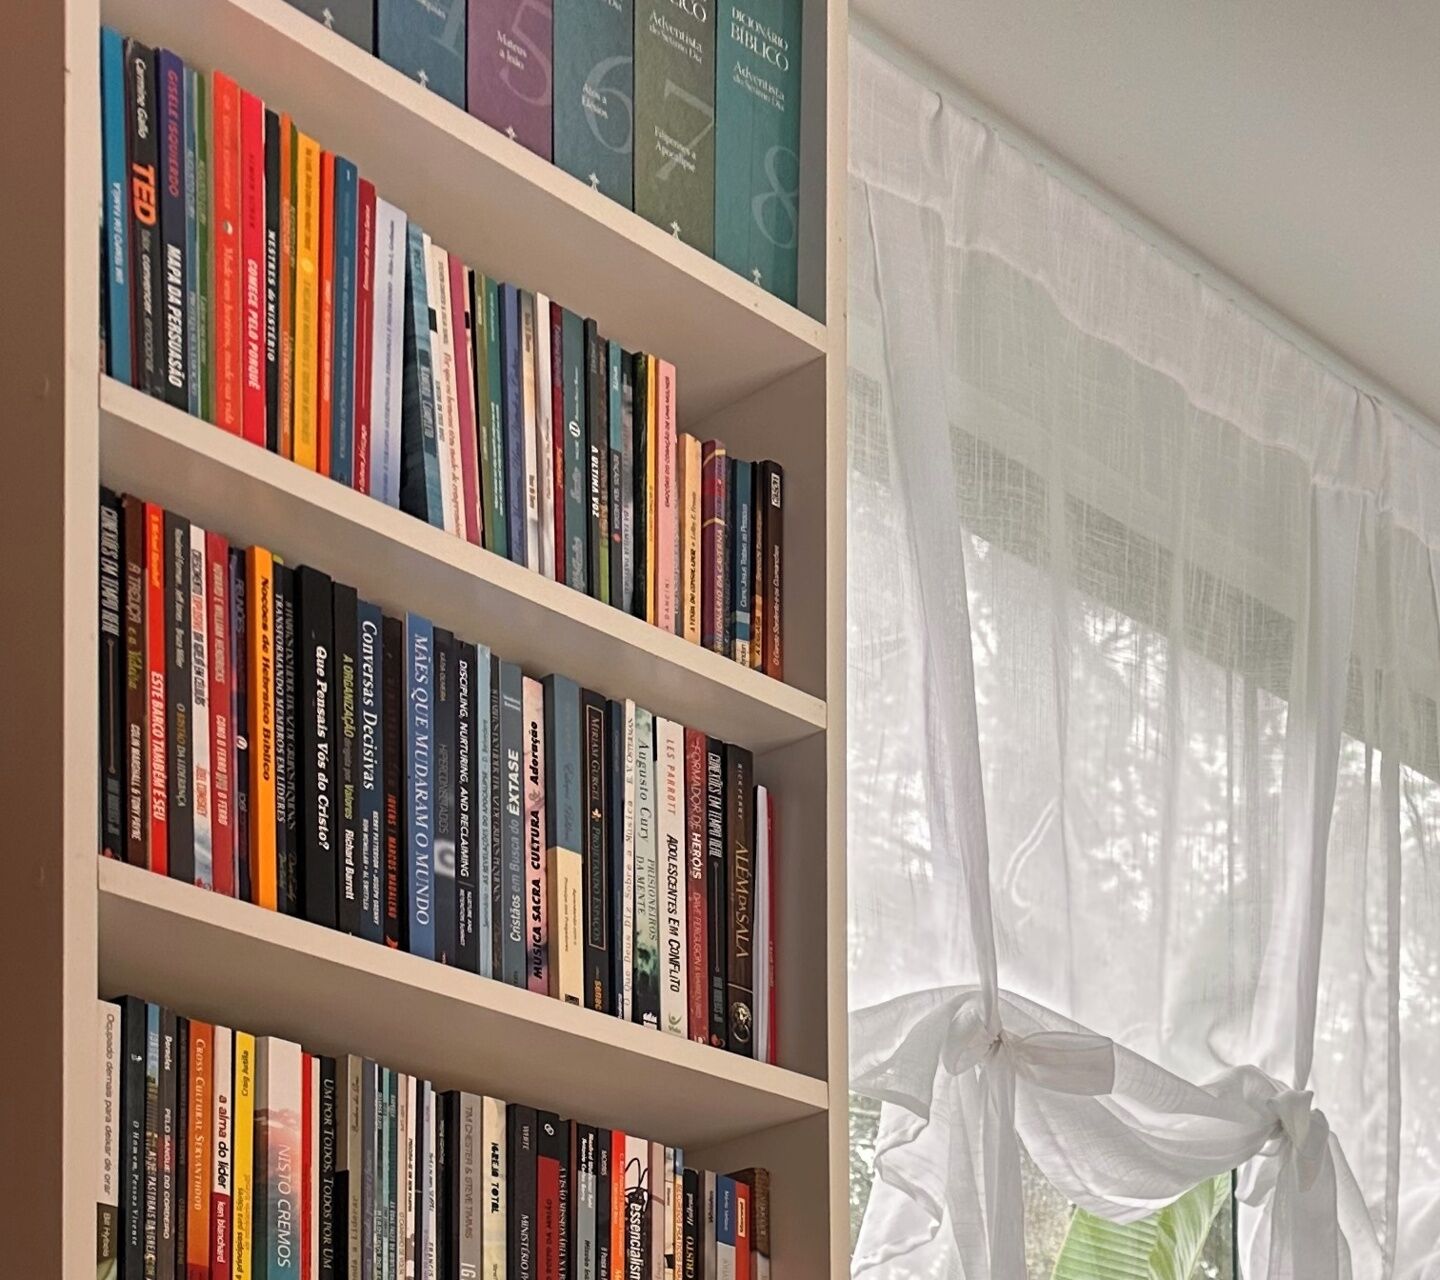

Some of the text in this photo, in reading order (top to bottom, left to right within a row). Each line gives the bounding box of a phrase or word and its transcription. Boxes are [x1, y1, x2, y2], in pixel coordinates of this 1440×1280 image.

[650, 10, 703, 53] Adventista
[730, 26, 789, 72] BÍBLICO
[732, 6, 788, 51] DICIONÁRIO
[733, 61, 785, 102] Adventista
[168, 70, 179, 198] GISELE ISQUIERDO
[132, 162, 158, 224] TED
[166, 244, 183, 388] MAPA DA PERSUASÃO
[247, 259, 260, 390] COMECE PELO PORQUÊ
[151, 671, 164, 696] ESTE
[151, 698, 164, 737] BARCO
[275, 593, 285, 822] TRANSFORMANDO MEMBROS EM LÍDERES
[361, 621, 378, 790] Conversas Decisivas
[152, 740, 165, 785] TAMBÉM
[315, 646, 329, 850] Que Pensais Vós do Cristo?
[414, 633, 430, 925] MÃES QUE MUDARAM O MUNDO
[666, 739, 675, 816] LES PARROTT
[152, 798, 166, 821] SEU
[636, 739, 652, 842] Augusto Cury
[507, 749, 522, 942] Cristãos em Busca do ÊXTASE
[635, 856, 646, 915] DA MENTE
[647, 858, 657, 941] PRISIONEIROS
[104, 1014, 115, 1194] Ocupado demais para deixar de orar
[217, 1095, 229, 1189] a alma do líder
[277, 1144, 291, 1267] NISTO CREMOS
[490, 1142, 500, 1214] IGREJA TOTAL
[520, 1214, 530, 1268] MINISTÉRIO
